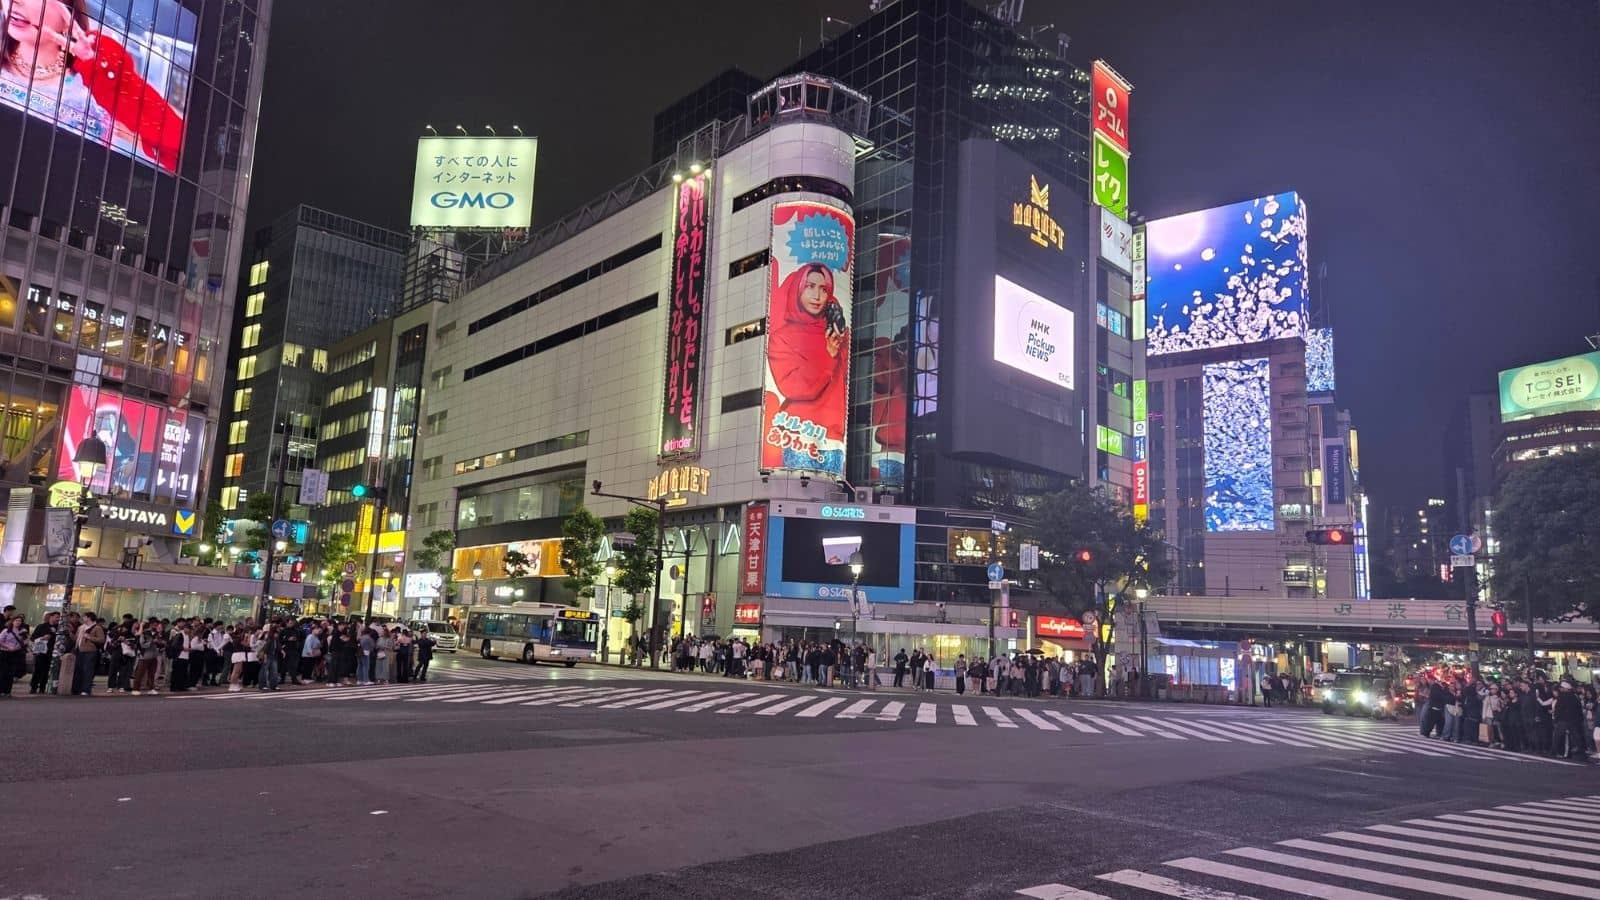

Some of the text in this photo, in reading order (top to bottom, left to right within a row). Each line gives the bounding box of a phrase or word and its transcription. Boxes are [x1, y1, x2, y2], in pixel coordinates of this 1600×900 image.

[434, 155, 519, 168] すべての人に
[433, 171, 516, 184] インターネット
[1097, 143, 1121, 200] レイク
[430, 191, 515, 209] GMO
[804, 227, 842, 240] 新しいこと
[811, 251, 839, 261] メルカリ
[1031, 319, 1050, 335] NHK
[1028, 332, 1056, 355] Pickup
[1025, 344, 1049, 362] NEWS
[1525, 373, 1582, 393] TOSEI
[767, 428, 824, 463] ありかも。
[648, 466, 711, 501] MAGNET
[98, 504, 167, 526] TSUTAYA
[746, 522, 761, 588] 天津甘栗
[1334, 604, 1352, 616] JR
